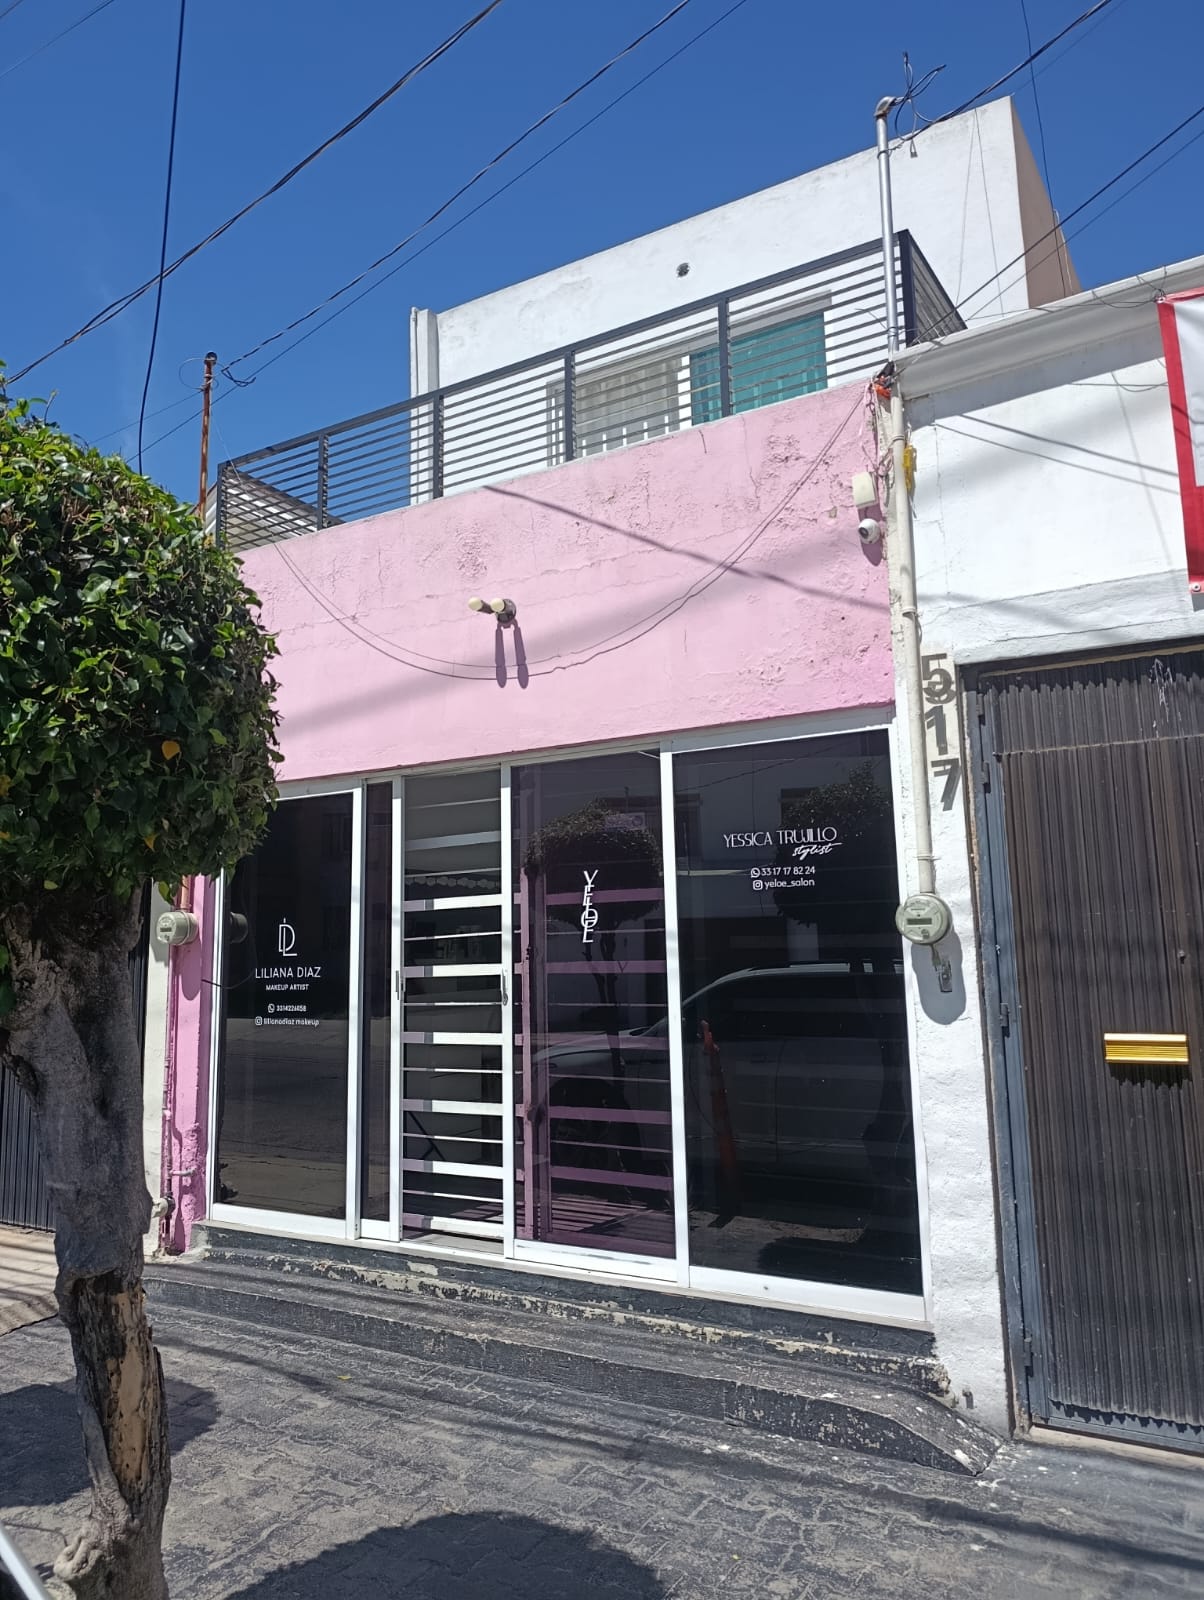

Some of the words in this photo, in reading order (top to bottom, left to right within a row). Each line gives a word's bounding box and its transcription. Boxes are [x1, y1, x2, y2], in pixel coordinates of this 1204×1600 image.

[921, 652, 961, 807] 517
[723, 831, 773, 848] YESSICA
[776, 826, 838, 845] TRUJILLO
[792, 842, 843, 860] stylist
[761, 867, 772, 876] 33
[772, 866, 782, 875] 17
[783, 866, 792, 875] 17
[793, 866, 804, 875] 82
[804, 865, 816, 875] 24
[764, 877, 816, 890] yeloe_salon
[255, 967, 294, 979] LILIANA
[297, 966, 321, 978] DIAZ
[289, 983, 310, 991] ARTIST
